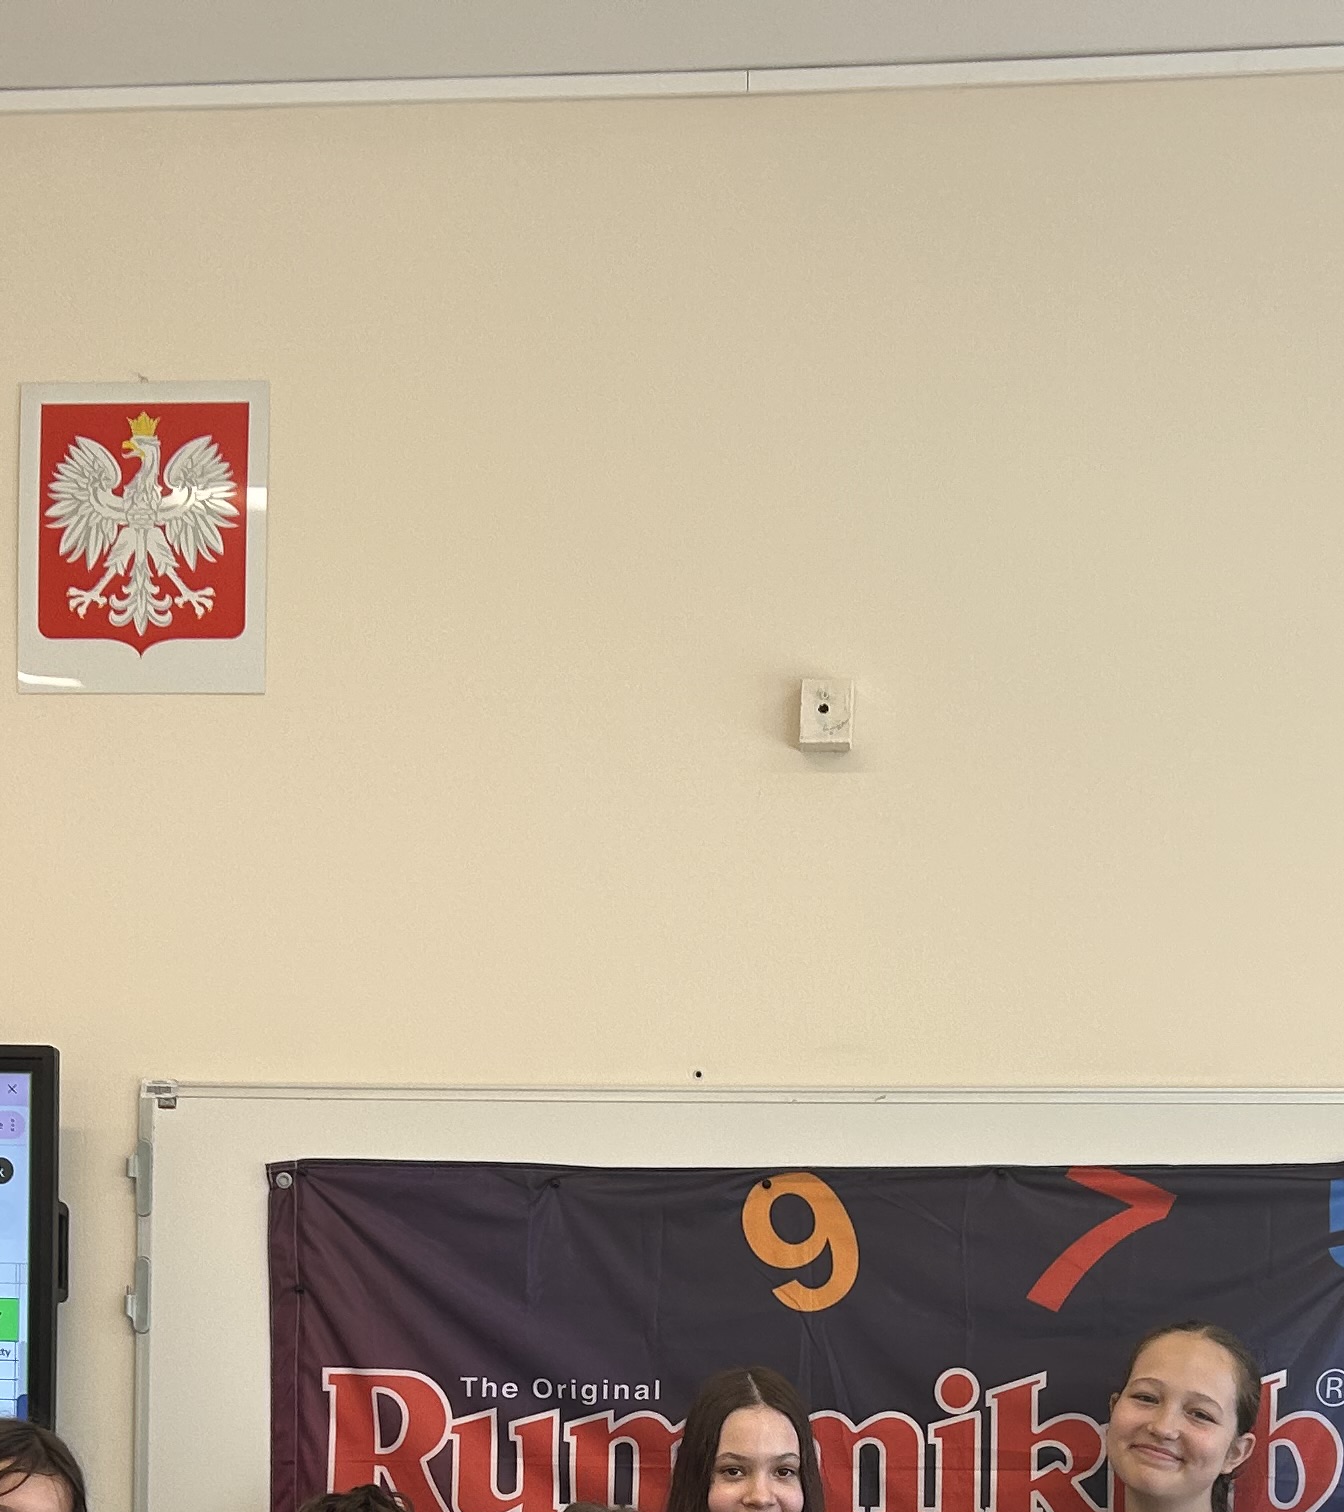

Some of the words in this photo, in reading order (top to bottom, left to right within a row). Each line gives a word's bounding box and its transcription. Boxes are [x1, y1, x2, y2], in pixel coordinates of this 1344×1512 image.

[741, 1171, 860, 1313] 9
[1025, 1167, 1179, 1312] 7
[461, 1374, 524, 1401] The
[532, 1376, 662, 1405] Original
